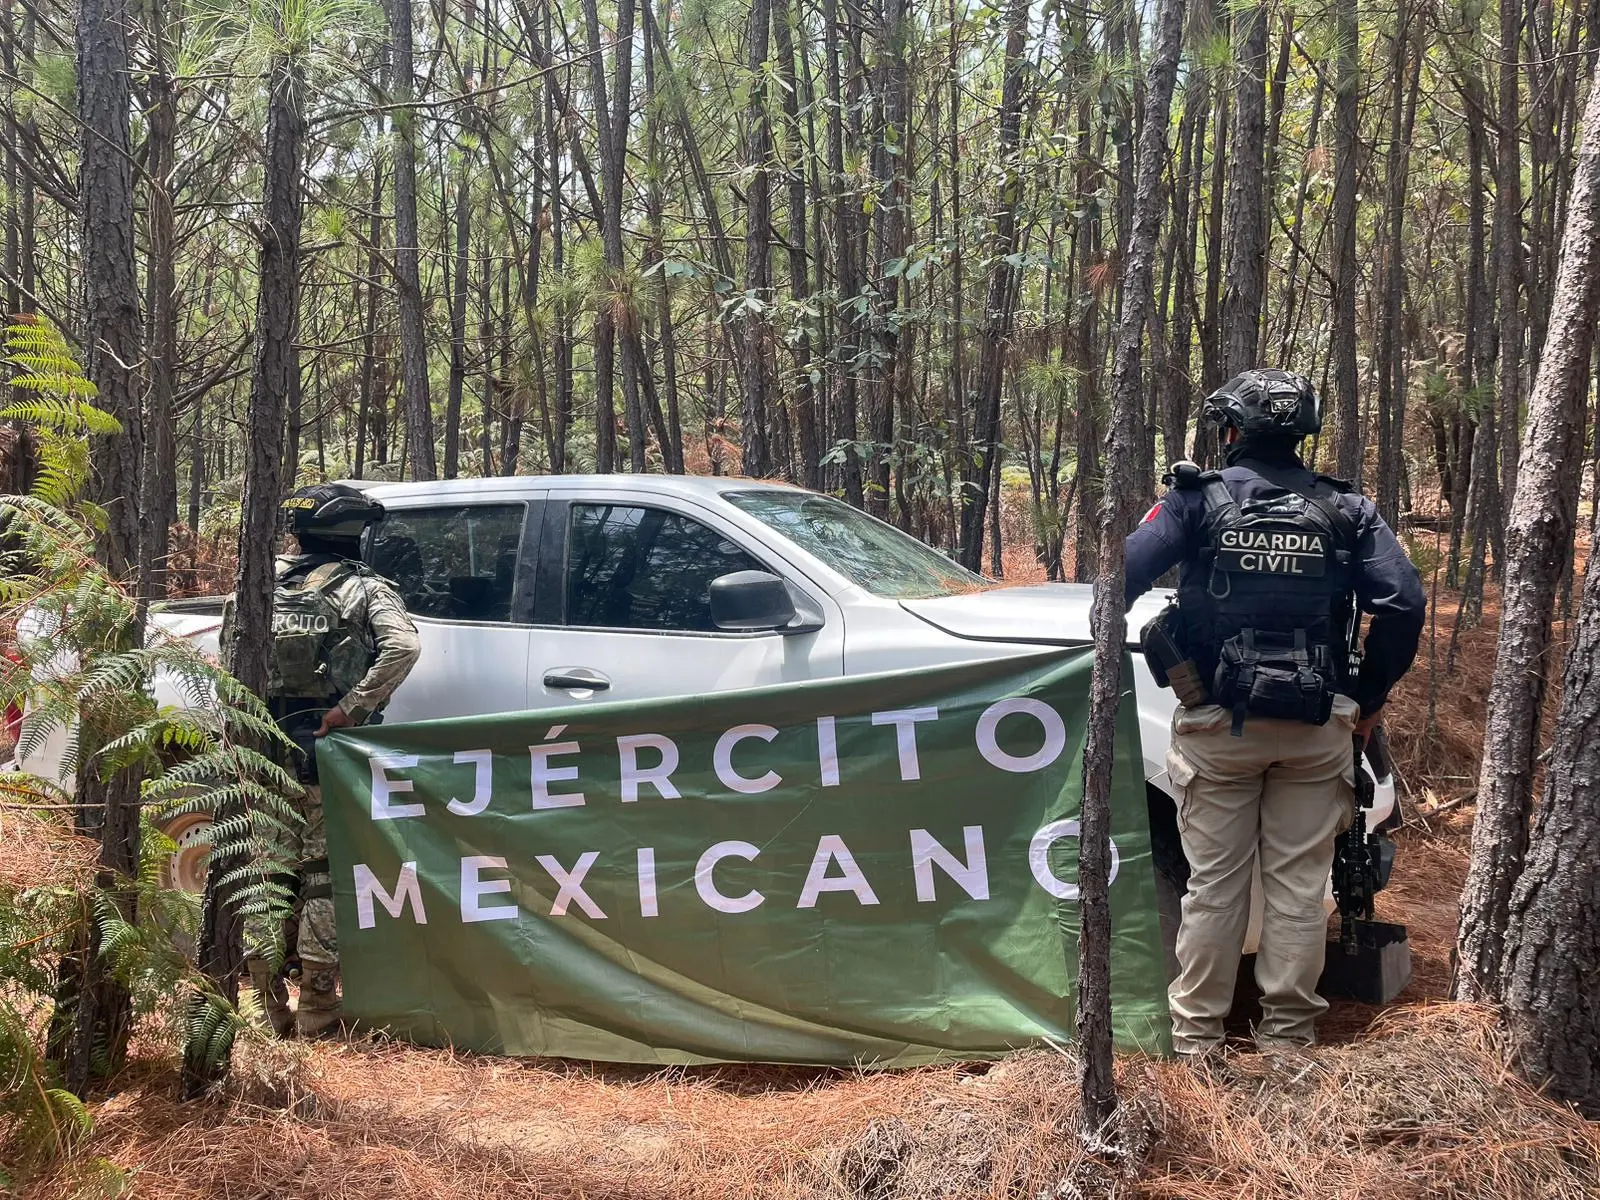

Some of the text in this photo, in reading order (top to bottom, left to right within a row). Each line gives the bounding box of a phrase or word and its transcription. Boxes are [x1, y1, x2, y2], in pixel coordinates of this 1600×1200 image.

[1221, 531, 1324, 553] GUARDIA
[1240, 554, 1303, 574] CIVIL
[272, 613, 328, 632] RCITO
[367, 697, 1067, 821] EJÉRCITO
[352, 819, 1120, 930] MEXICANO
